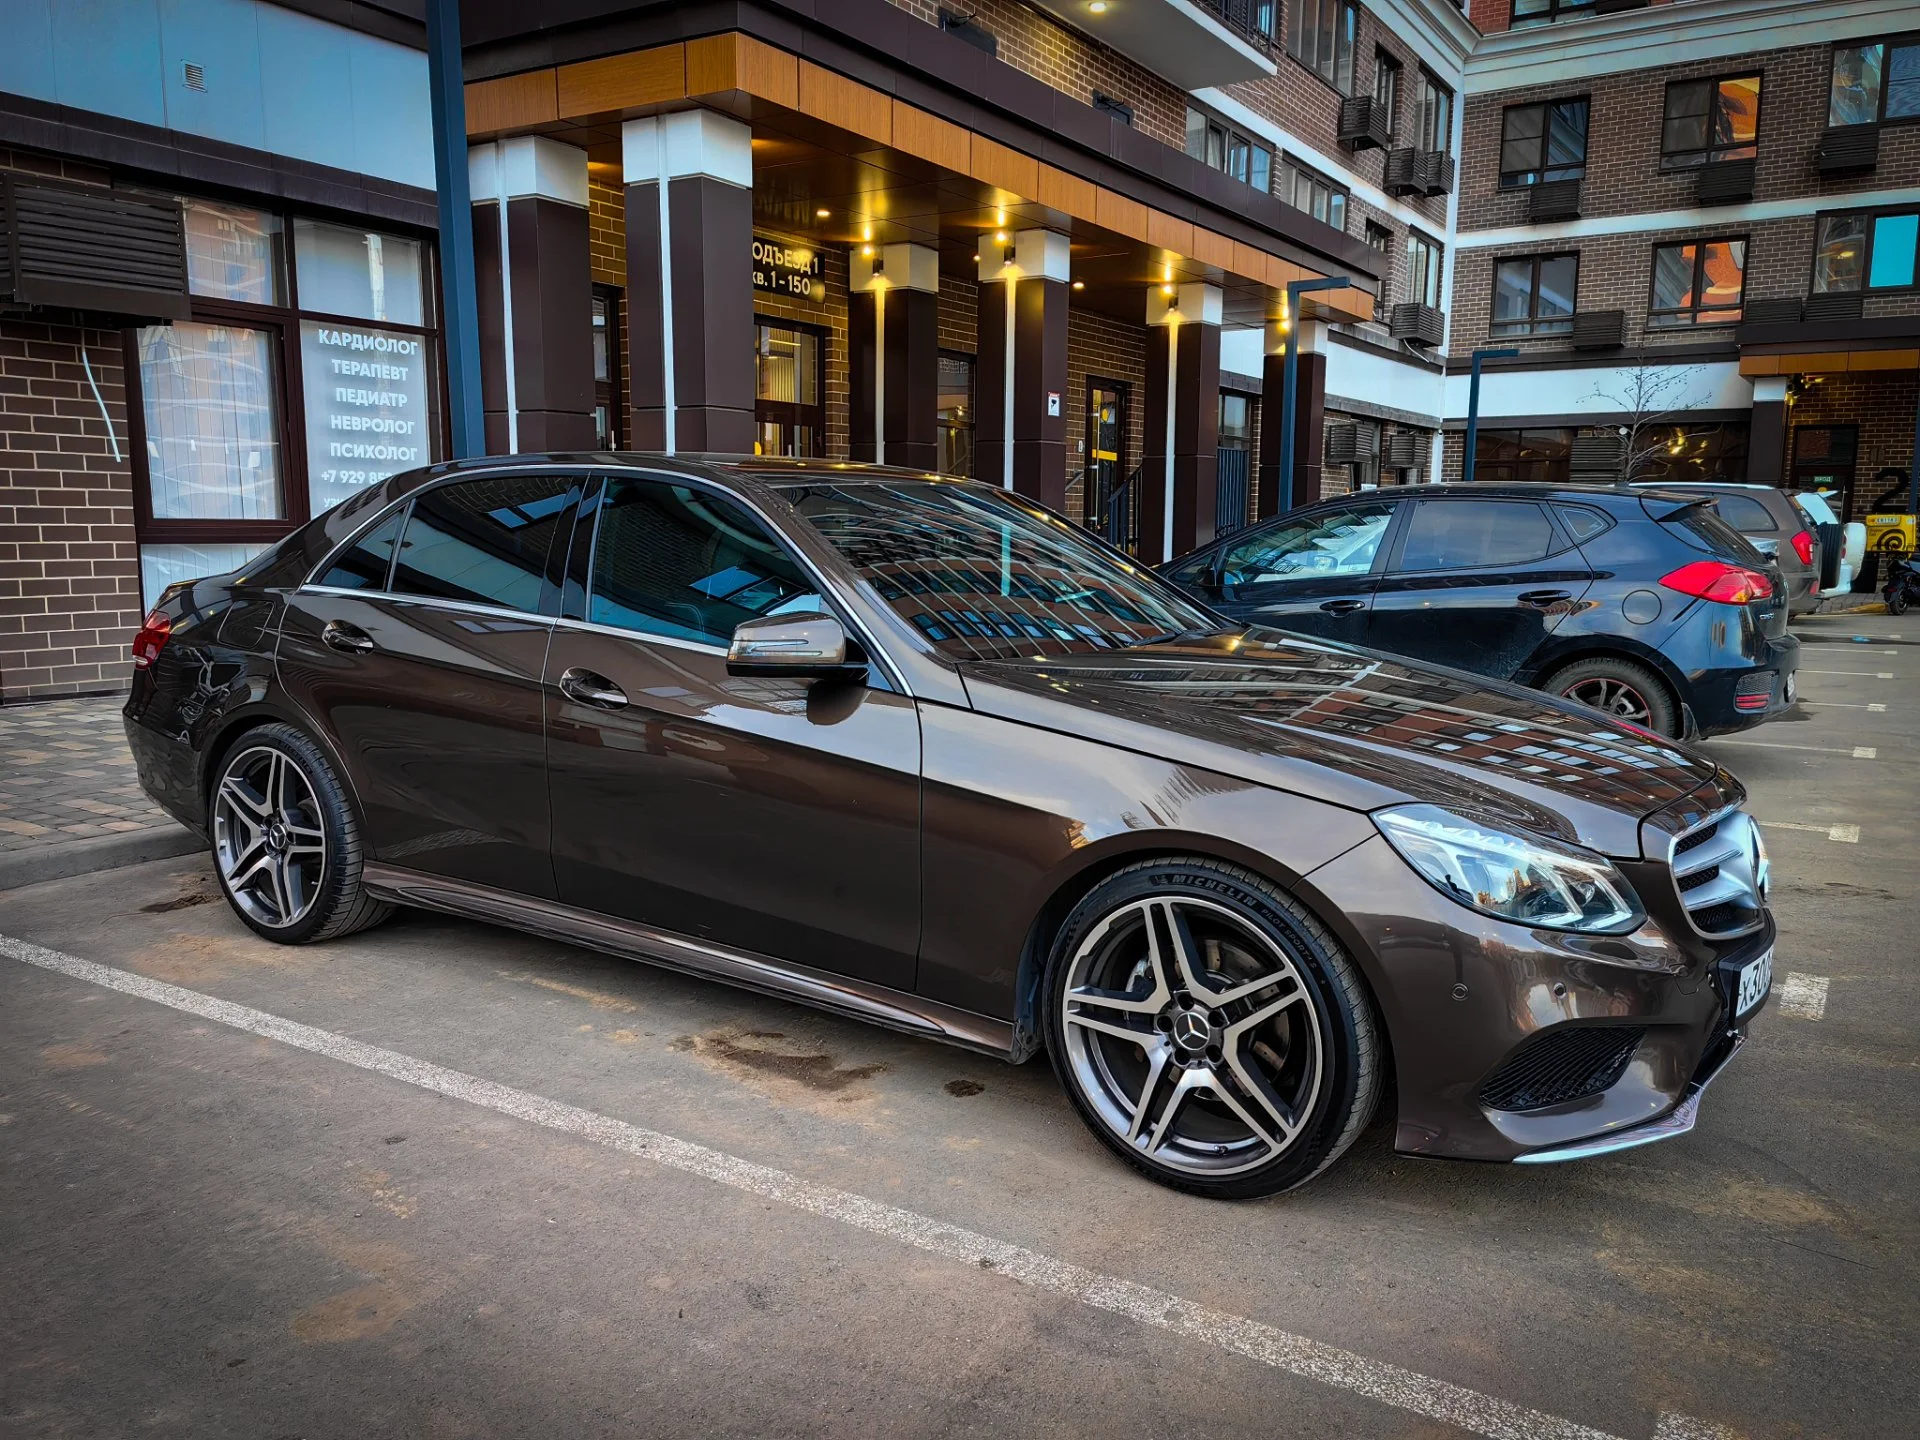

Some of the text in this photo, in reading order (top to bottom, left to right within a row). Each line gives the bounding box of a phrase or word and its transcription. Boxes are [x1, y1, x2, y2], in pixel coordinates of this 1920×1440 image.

[752, 241, 818, 275] ОДЪЕЗД 1
[318, 328, 418, 356] КАРДИОЛОГ
[331, 359, 408, 381] ТЕРАПЕВТ
[335, 387, 408, 408] ПЕДИАТР
[330, 414, 415, 434] НЕВРОЛОГ
[330, 442, 418, 461] ПСИХОЛОГ
[321, 469, 337, 483] +7
[340, 470, 366, 484] 929
[1871, 467, 1909, 514] 2
[1172, 874, 1257, 906] MICHELIN
[1260, 908, 1285, 928] PILOT
[1284, 929, 1309, 957] SPORT
